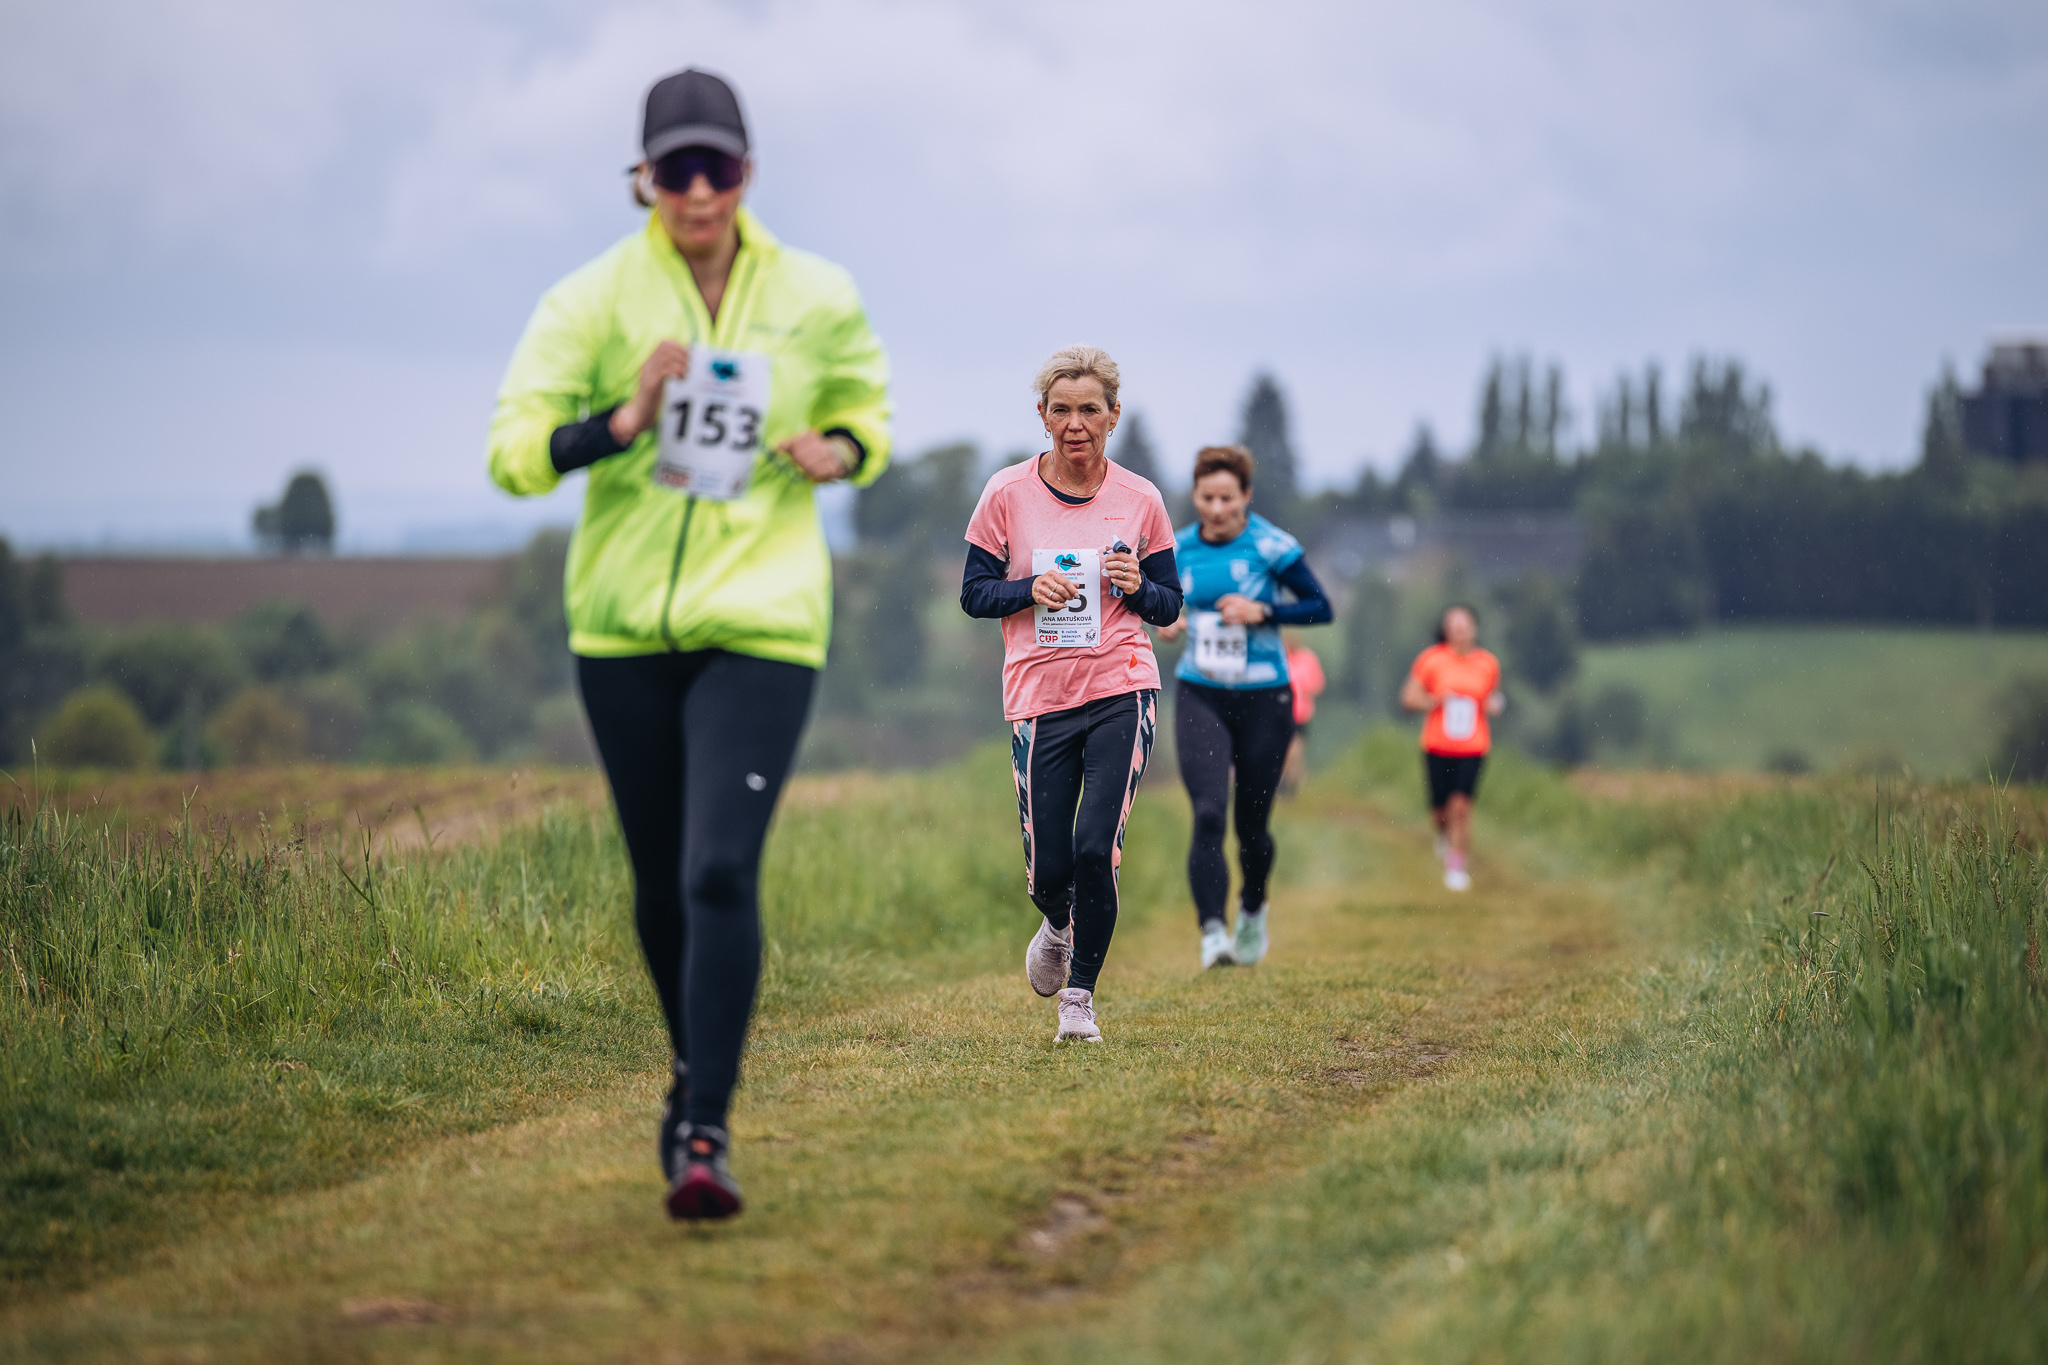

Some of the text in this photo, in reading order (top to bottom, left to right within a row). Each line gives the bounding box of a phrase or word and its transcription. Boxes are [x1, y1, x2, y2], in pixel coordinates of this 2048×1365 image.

[670, 396, 762, 452] 153
[1047, 584, 1088, 613] 5
[1039, 635, 1058, 643] CUP
